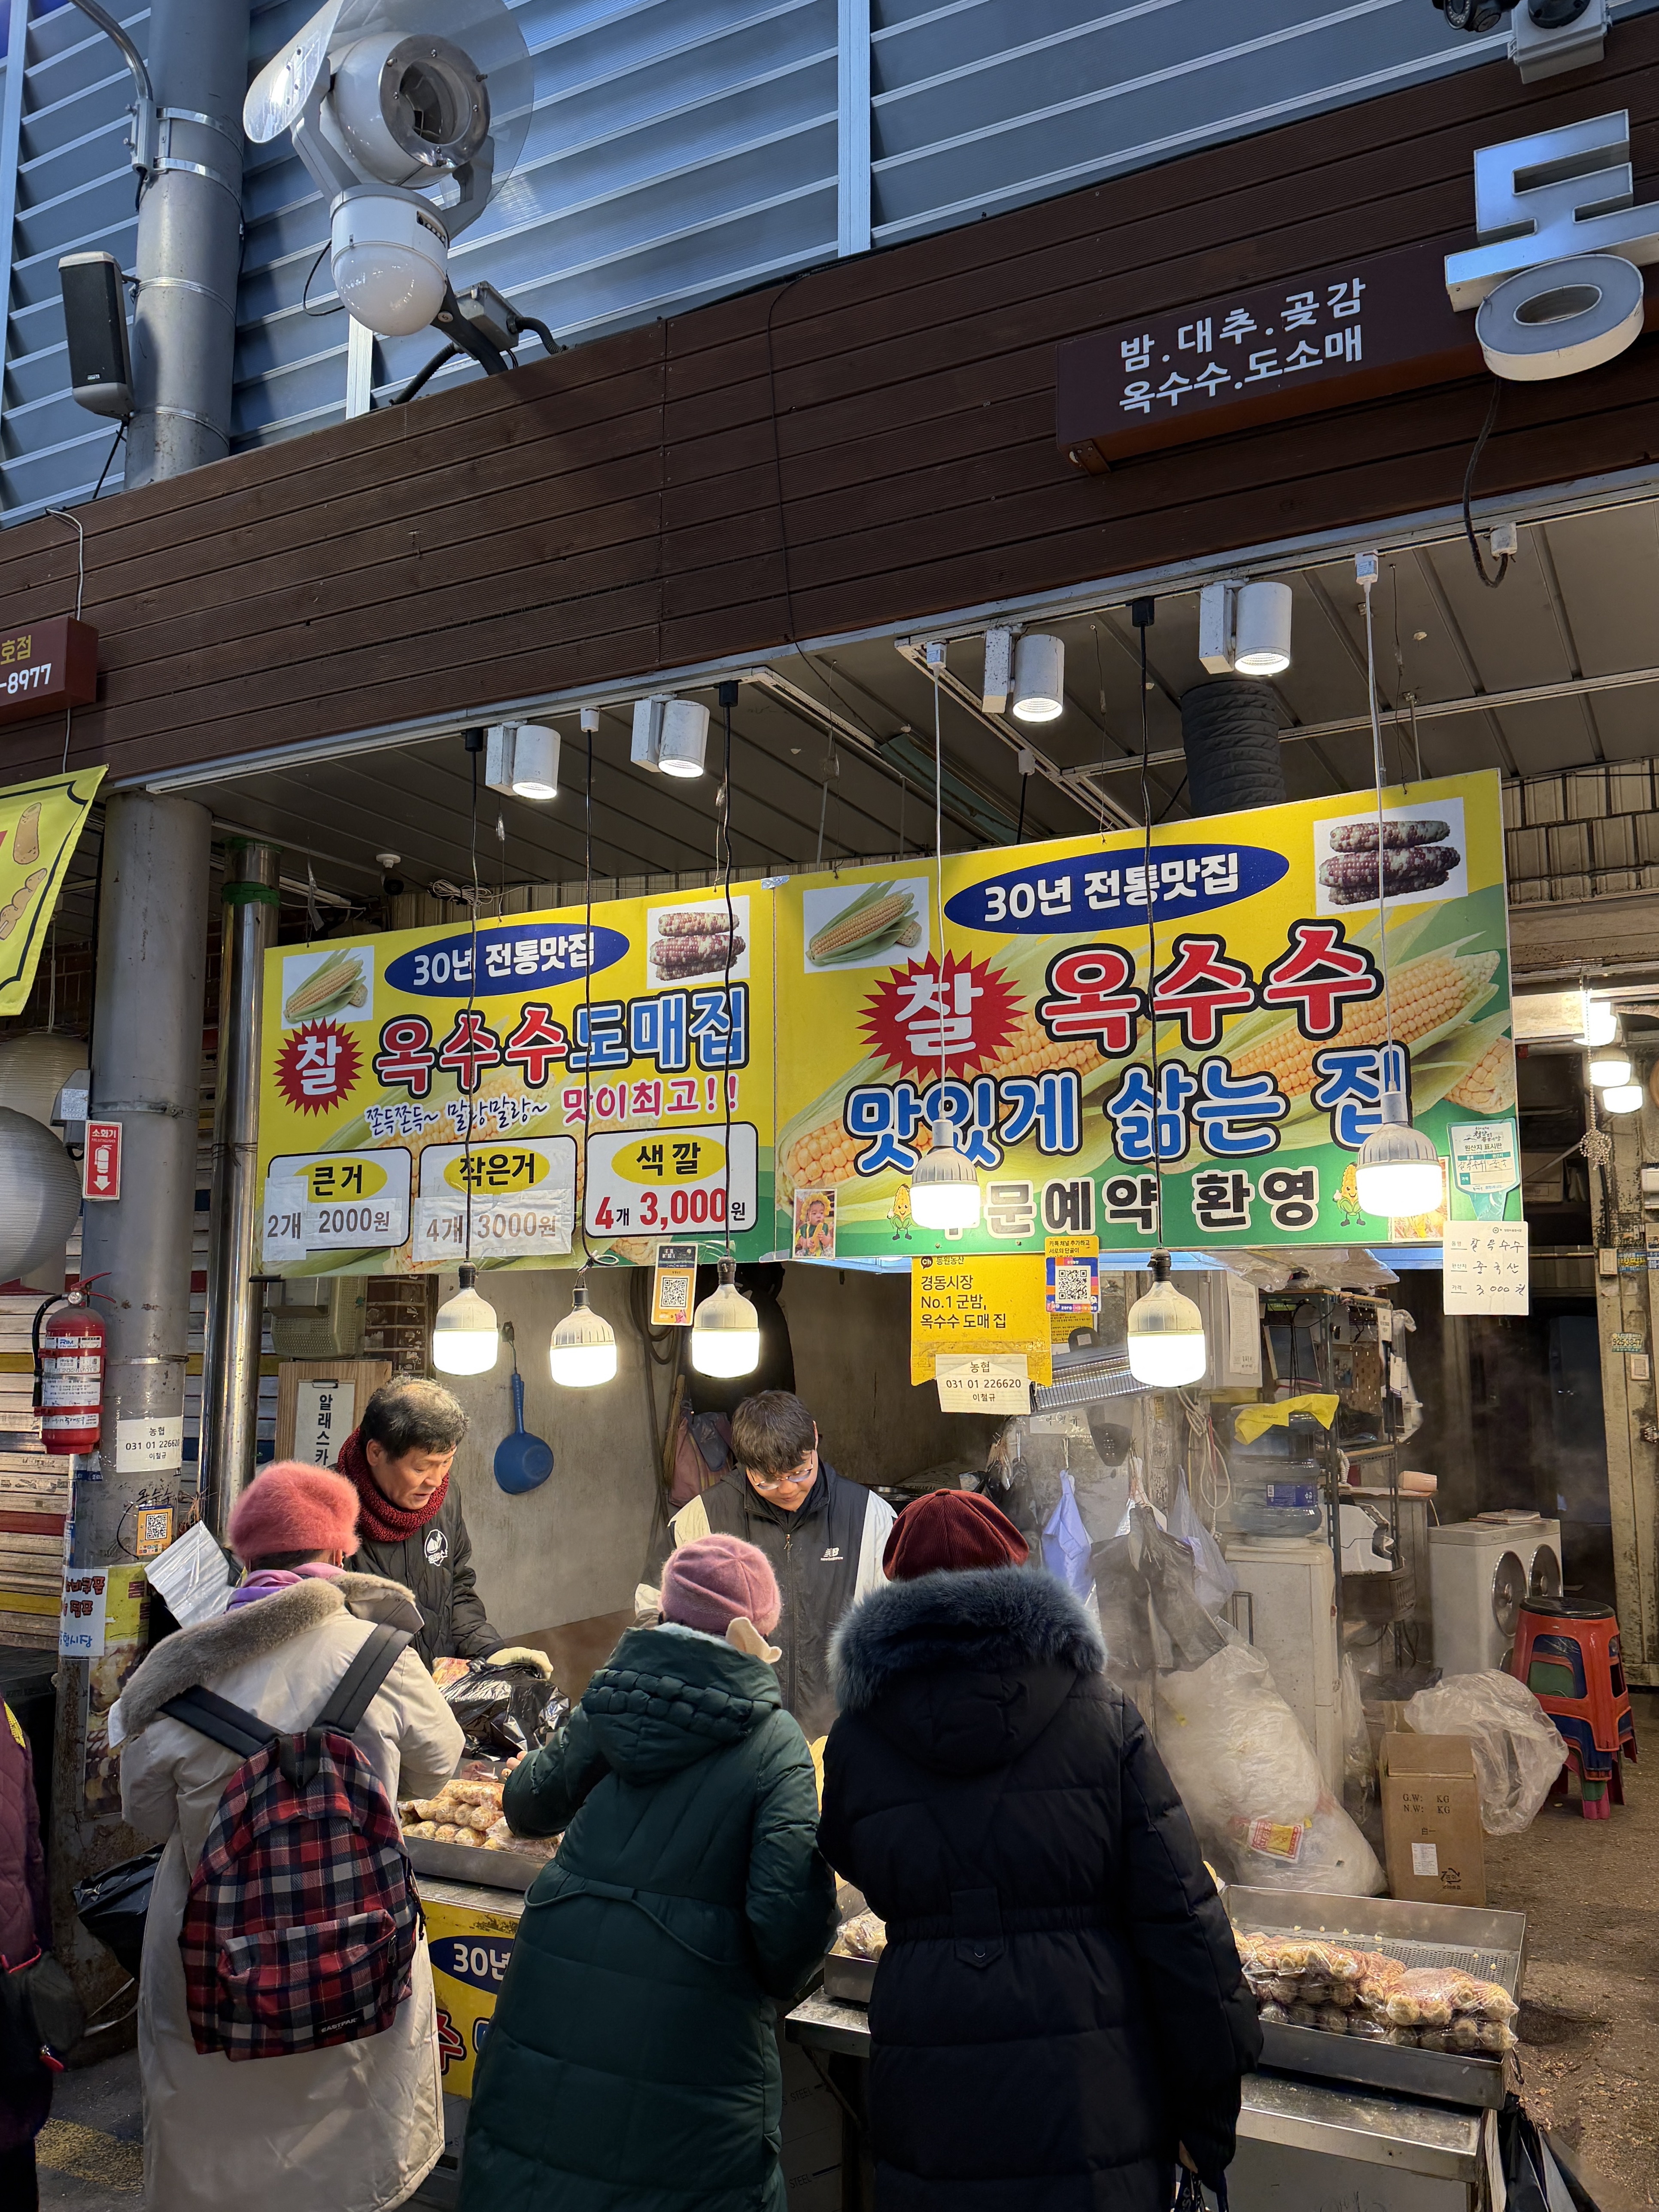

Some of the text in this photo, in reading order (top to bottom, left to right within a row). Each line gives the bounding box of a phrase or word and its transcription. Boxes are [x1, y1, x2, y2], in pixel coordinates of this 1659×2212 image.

[985, 853, 1239, 922] 30년 전통맛집
[413, 933, 595, 986] 30년 전통맛집
[1038, 922, 1379, 1056] 옥수수
[895, 972, 984, 1056] 찰
[296, 1035, 342, 1096] 찰
[845, 1042, 1410, 1176] 맛있게 삶는 집
[92, 1128, 116, 1139] 소화기
[459, 1153, 535, 1187] 작은거
[595, 1196, 630, 1229] 4개
[1191, 1166, 1319, 1232] 환영
[267, 1207, 390, 1240] 2개 2000원
[426, 1212, 556, 1244] 4개 3000원
[921, 1275, 973, 1291] 경동시장
[921, 1294, 987, 1310] No.1 군밤,
[920, 1313, 1006, 1329] 옥수수 도매 집
[969, 1361, 991, 1373] 농협
[946, 1379, 1021, 1389] 031 01 226620
[125, 1442, 142, 1450] 031
[149, 1426, 165, 1436] 농협
[315, 1394, 333, 1465] 알래스카
[1437, 1806, 1450, 1814] KG
